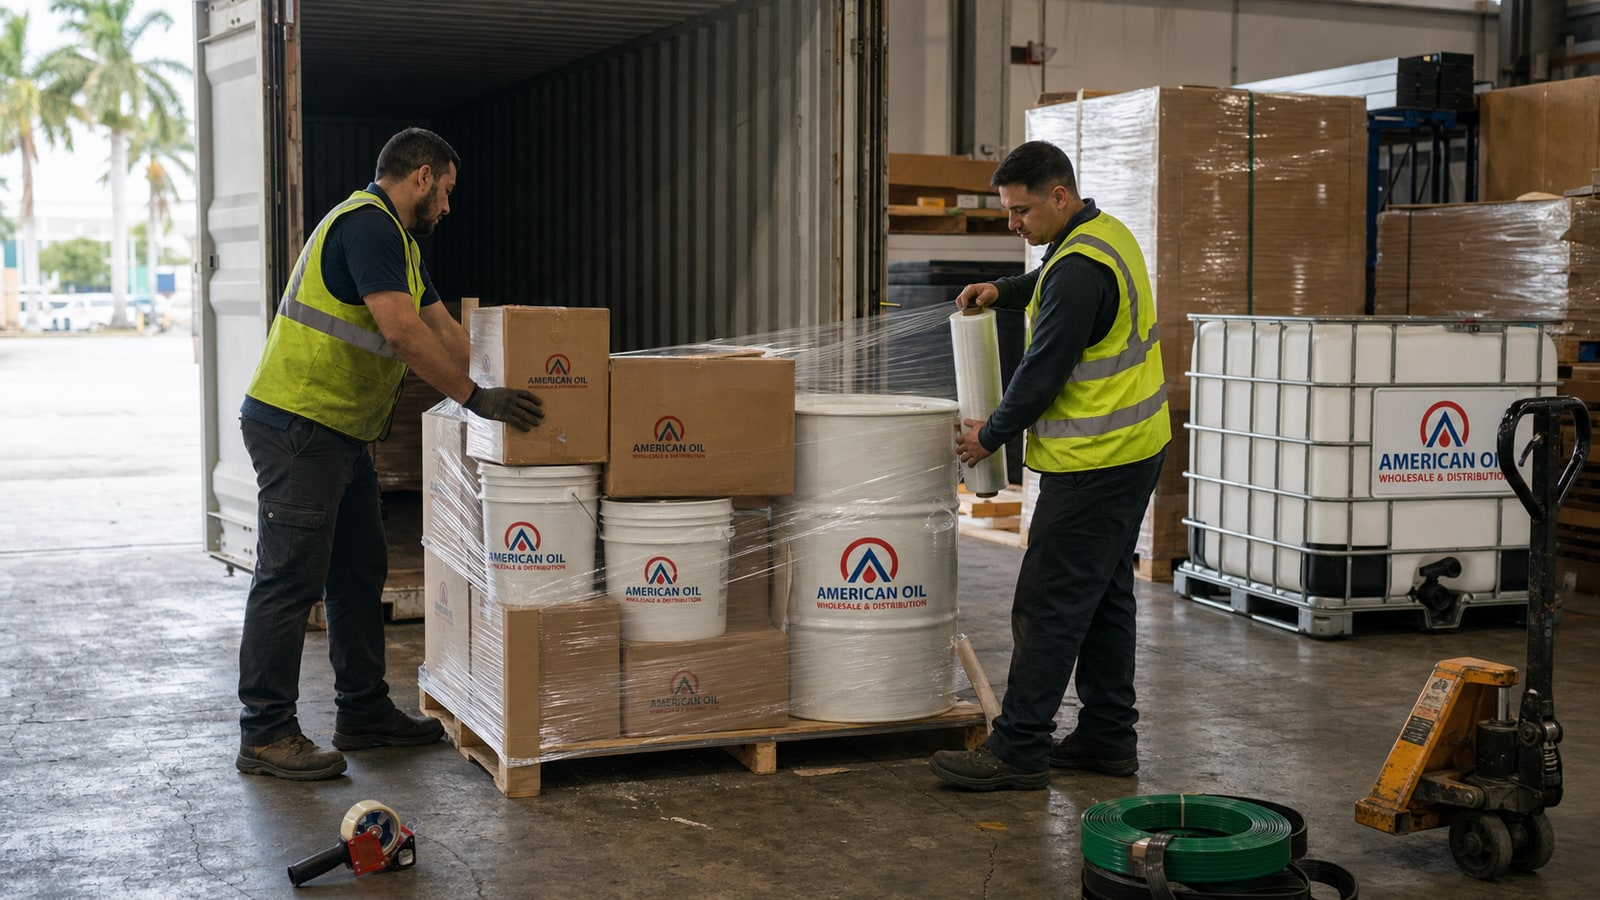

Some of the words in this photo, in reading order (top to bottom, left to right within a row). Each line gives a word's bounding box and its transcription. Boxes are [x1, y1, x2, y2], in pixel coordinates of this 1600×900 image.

[528, 376, 572, 384] AMERICAN
[574, 376, 588, 384] OIL
[633, 443, 686, 453] AMERICAN
[688, 443, 705, 452] OIL
[1379, 452, 1475, 470] AMERICAN
[1480, 451, 1498, 468] OI
[1379, 473, 1434, 483] WHOLESALE
[1437, 473, 1443, 482] &
[1447, 472, 1507, 482] DISTRIBUTIO
[546, 553, 566, 563] OIL
[625, 586, 679, 597] AMERICAN
[682, 586, 701, 596] OIL
[817, 586, 897, 600] AMERICAN
[902, 585, 927, 598] OIL
[817, 601, 861, 610] WHOLESALE
[873, 600, 927, 610] DISTRIBUTION
[650, 696, 701, 709] AMERICAN
[703, 695, 719, 705] OIL
